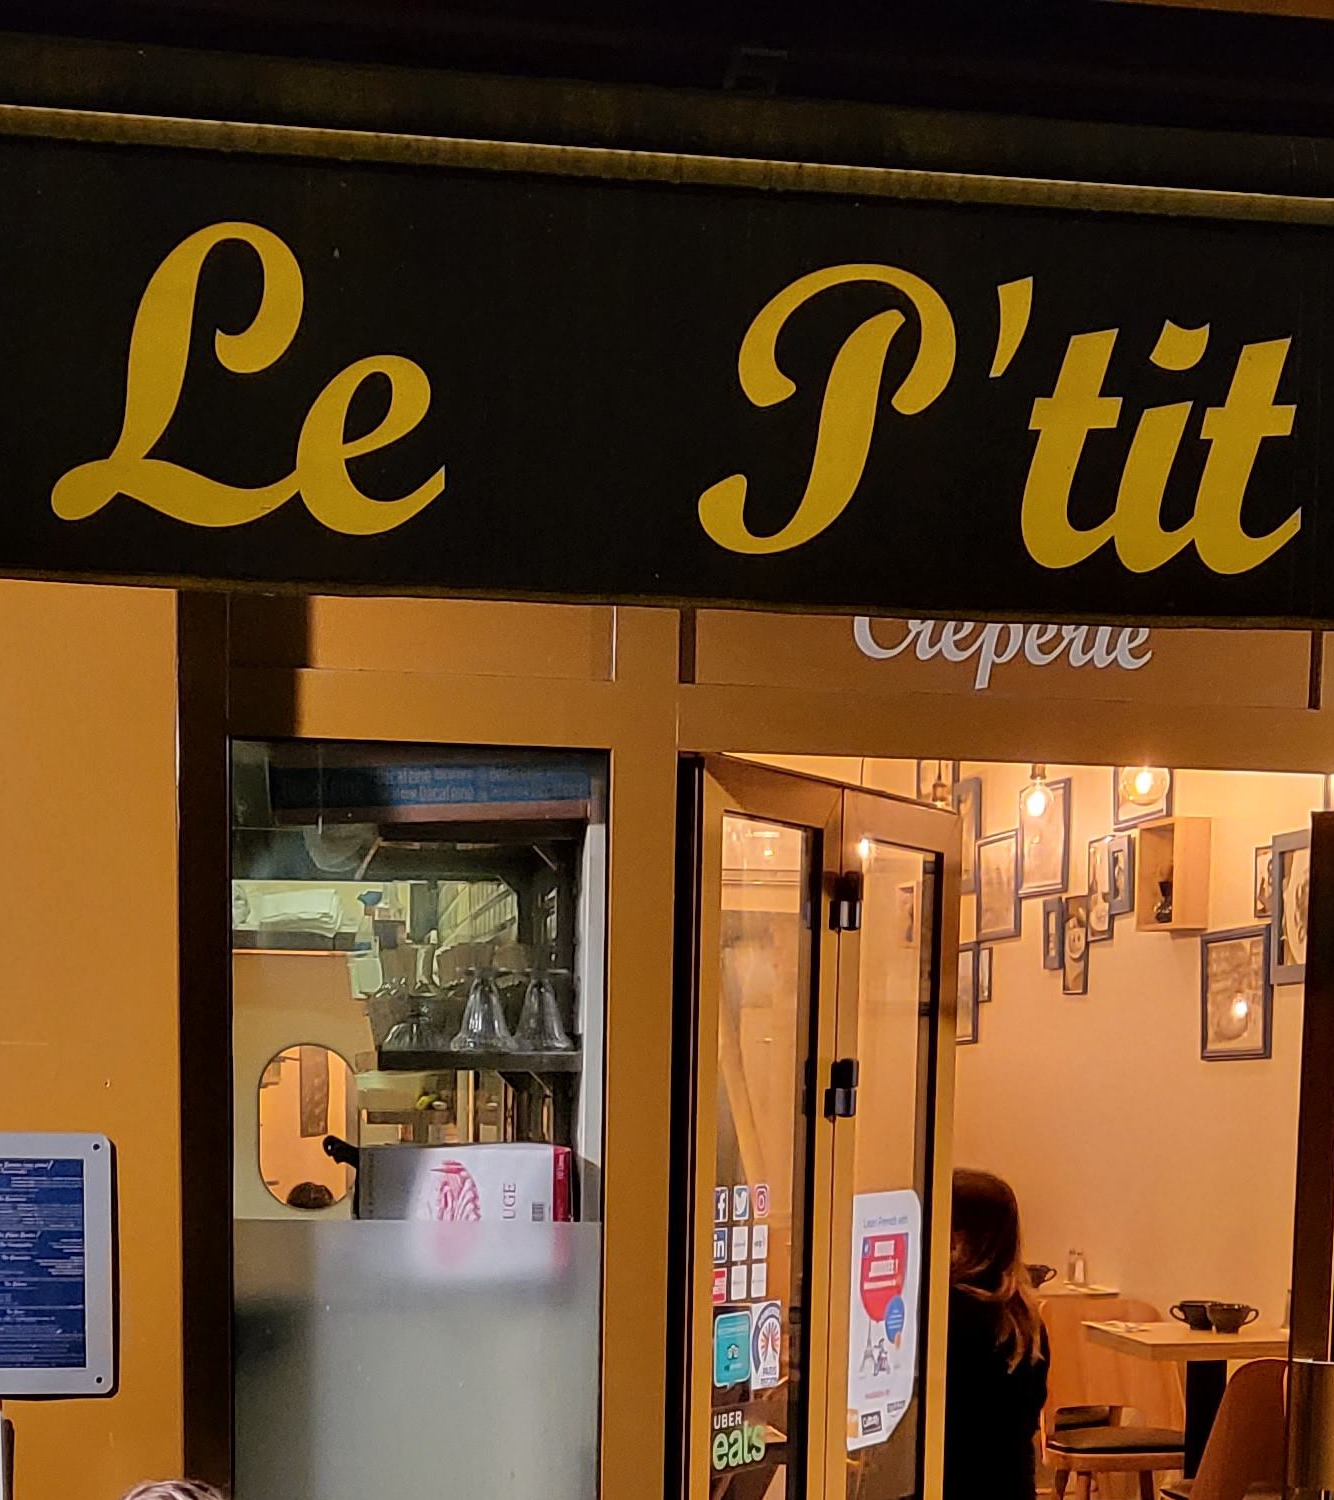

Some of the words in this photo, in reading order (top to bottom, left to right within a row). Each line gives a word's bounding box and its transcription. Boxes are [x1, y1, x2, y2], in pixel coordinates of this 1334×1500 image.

[51, 222, 445, 535] Le
[698, 263, 1302, 574] P'tit
[712, 1420, 766, 1470] eats
[713, 1410, 742, 1430] UBER
